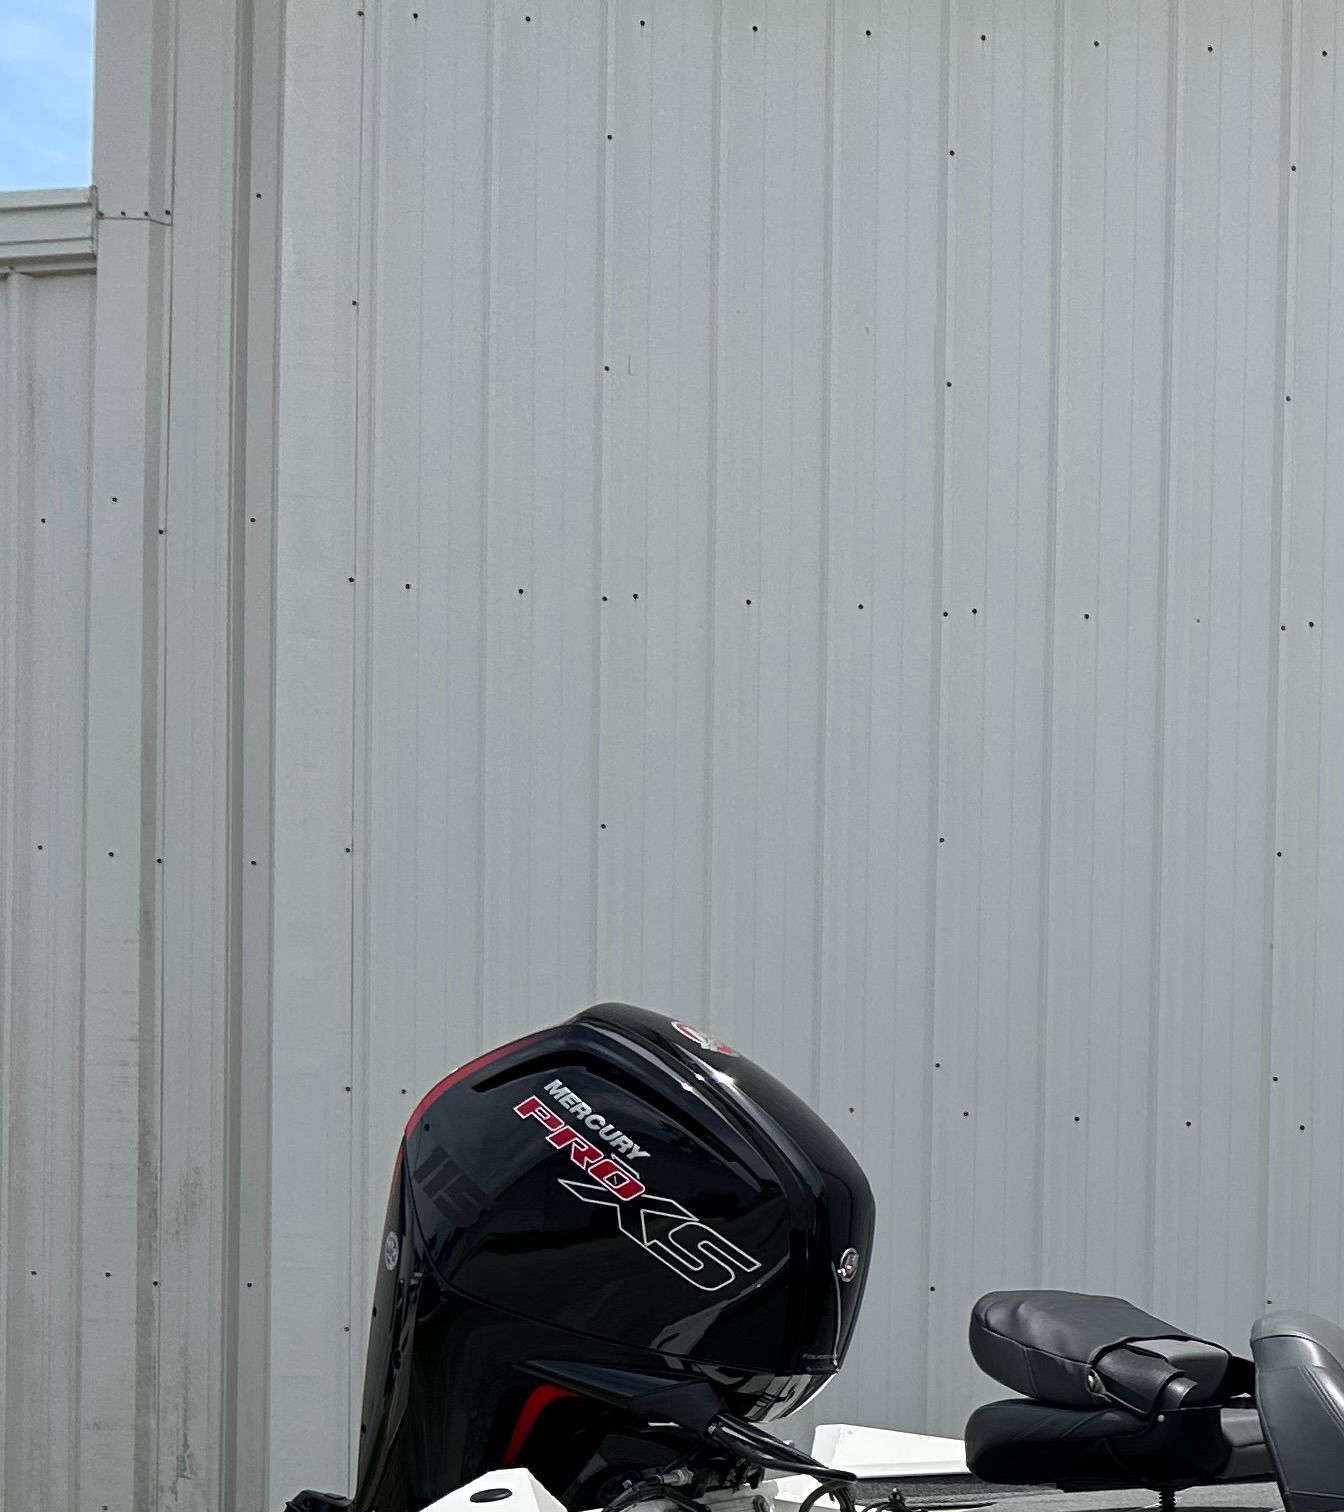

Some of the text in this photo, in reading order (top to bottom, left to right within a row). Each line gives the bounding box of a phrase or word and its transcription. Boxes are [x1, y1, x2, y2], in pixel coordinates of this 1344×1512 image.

[513, 1095, 646, 1201] PRO
[543, 1079, 652, 1160] MERCURY
[557, 1178, 762, 1291] XS
